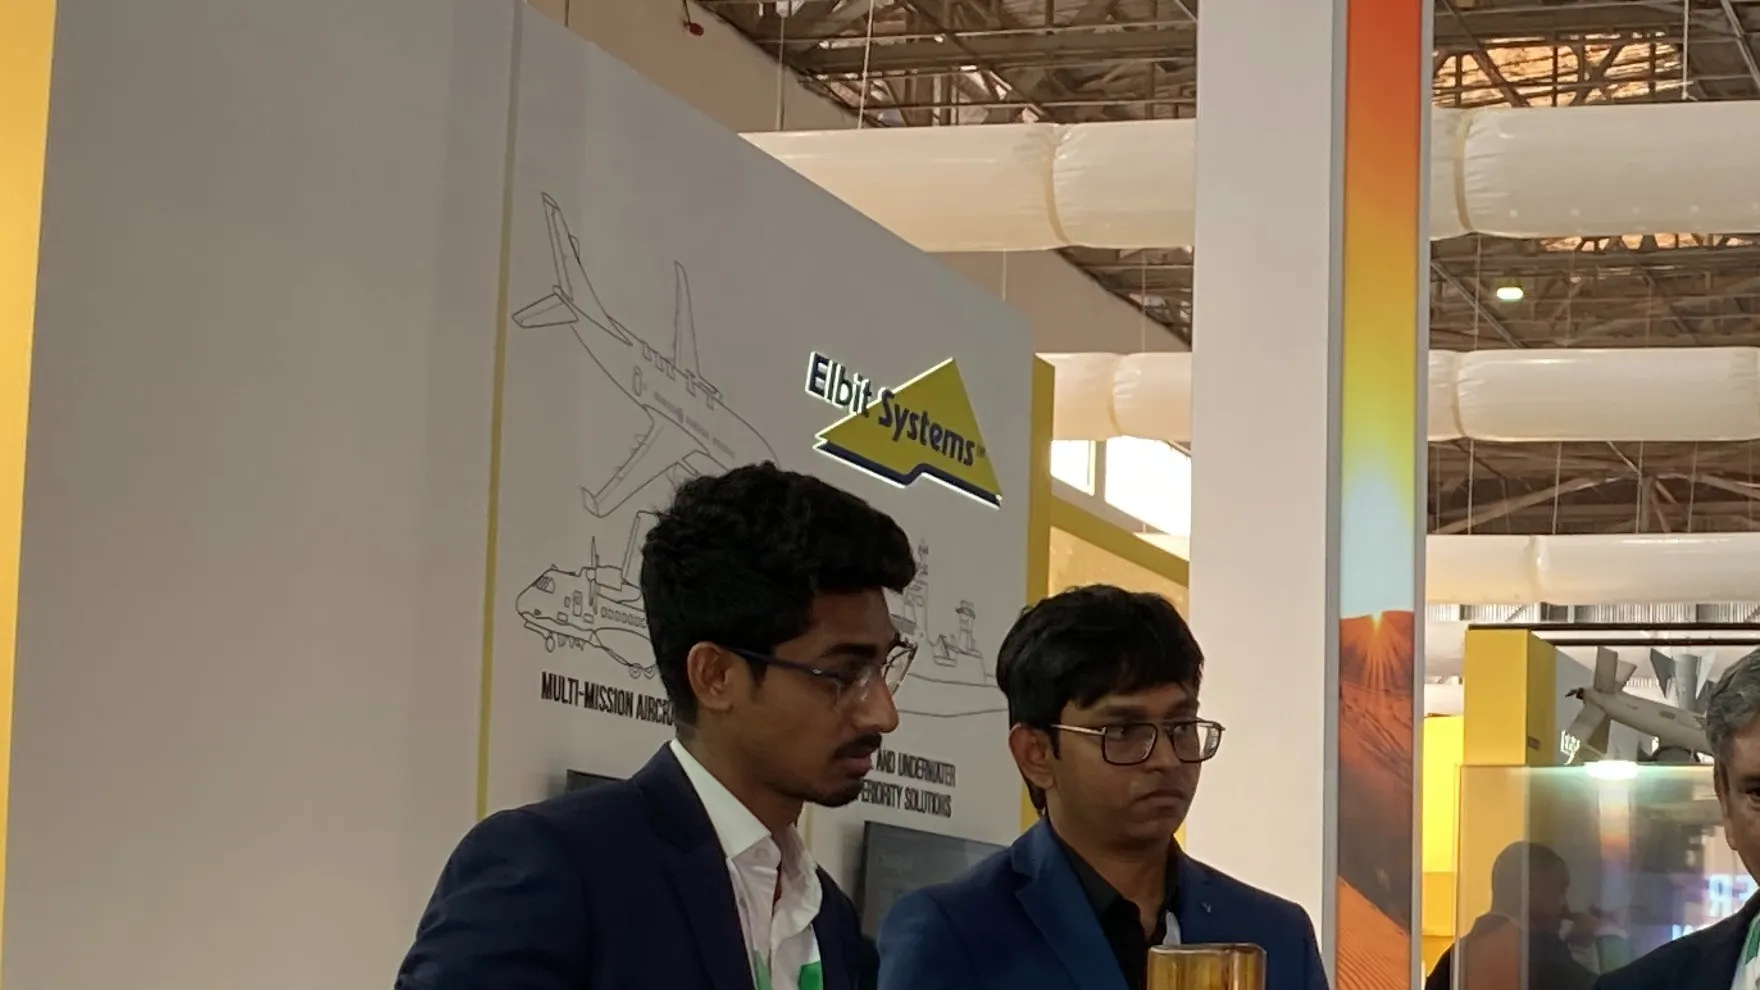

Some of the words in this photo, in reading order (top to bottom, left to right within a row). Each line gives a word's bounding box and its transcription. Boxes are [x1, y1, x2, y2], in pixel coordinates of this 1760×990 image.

[806, 352, 873, 418] Elbit
[878, 388, 976, 467] Systems
[541, 671, 634, 718] MULTI-MISSION
[636, 693, 674, 726] AIRCRA
[904, 786, 952, 818] SOLUTIONS
